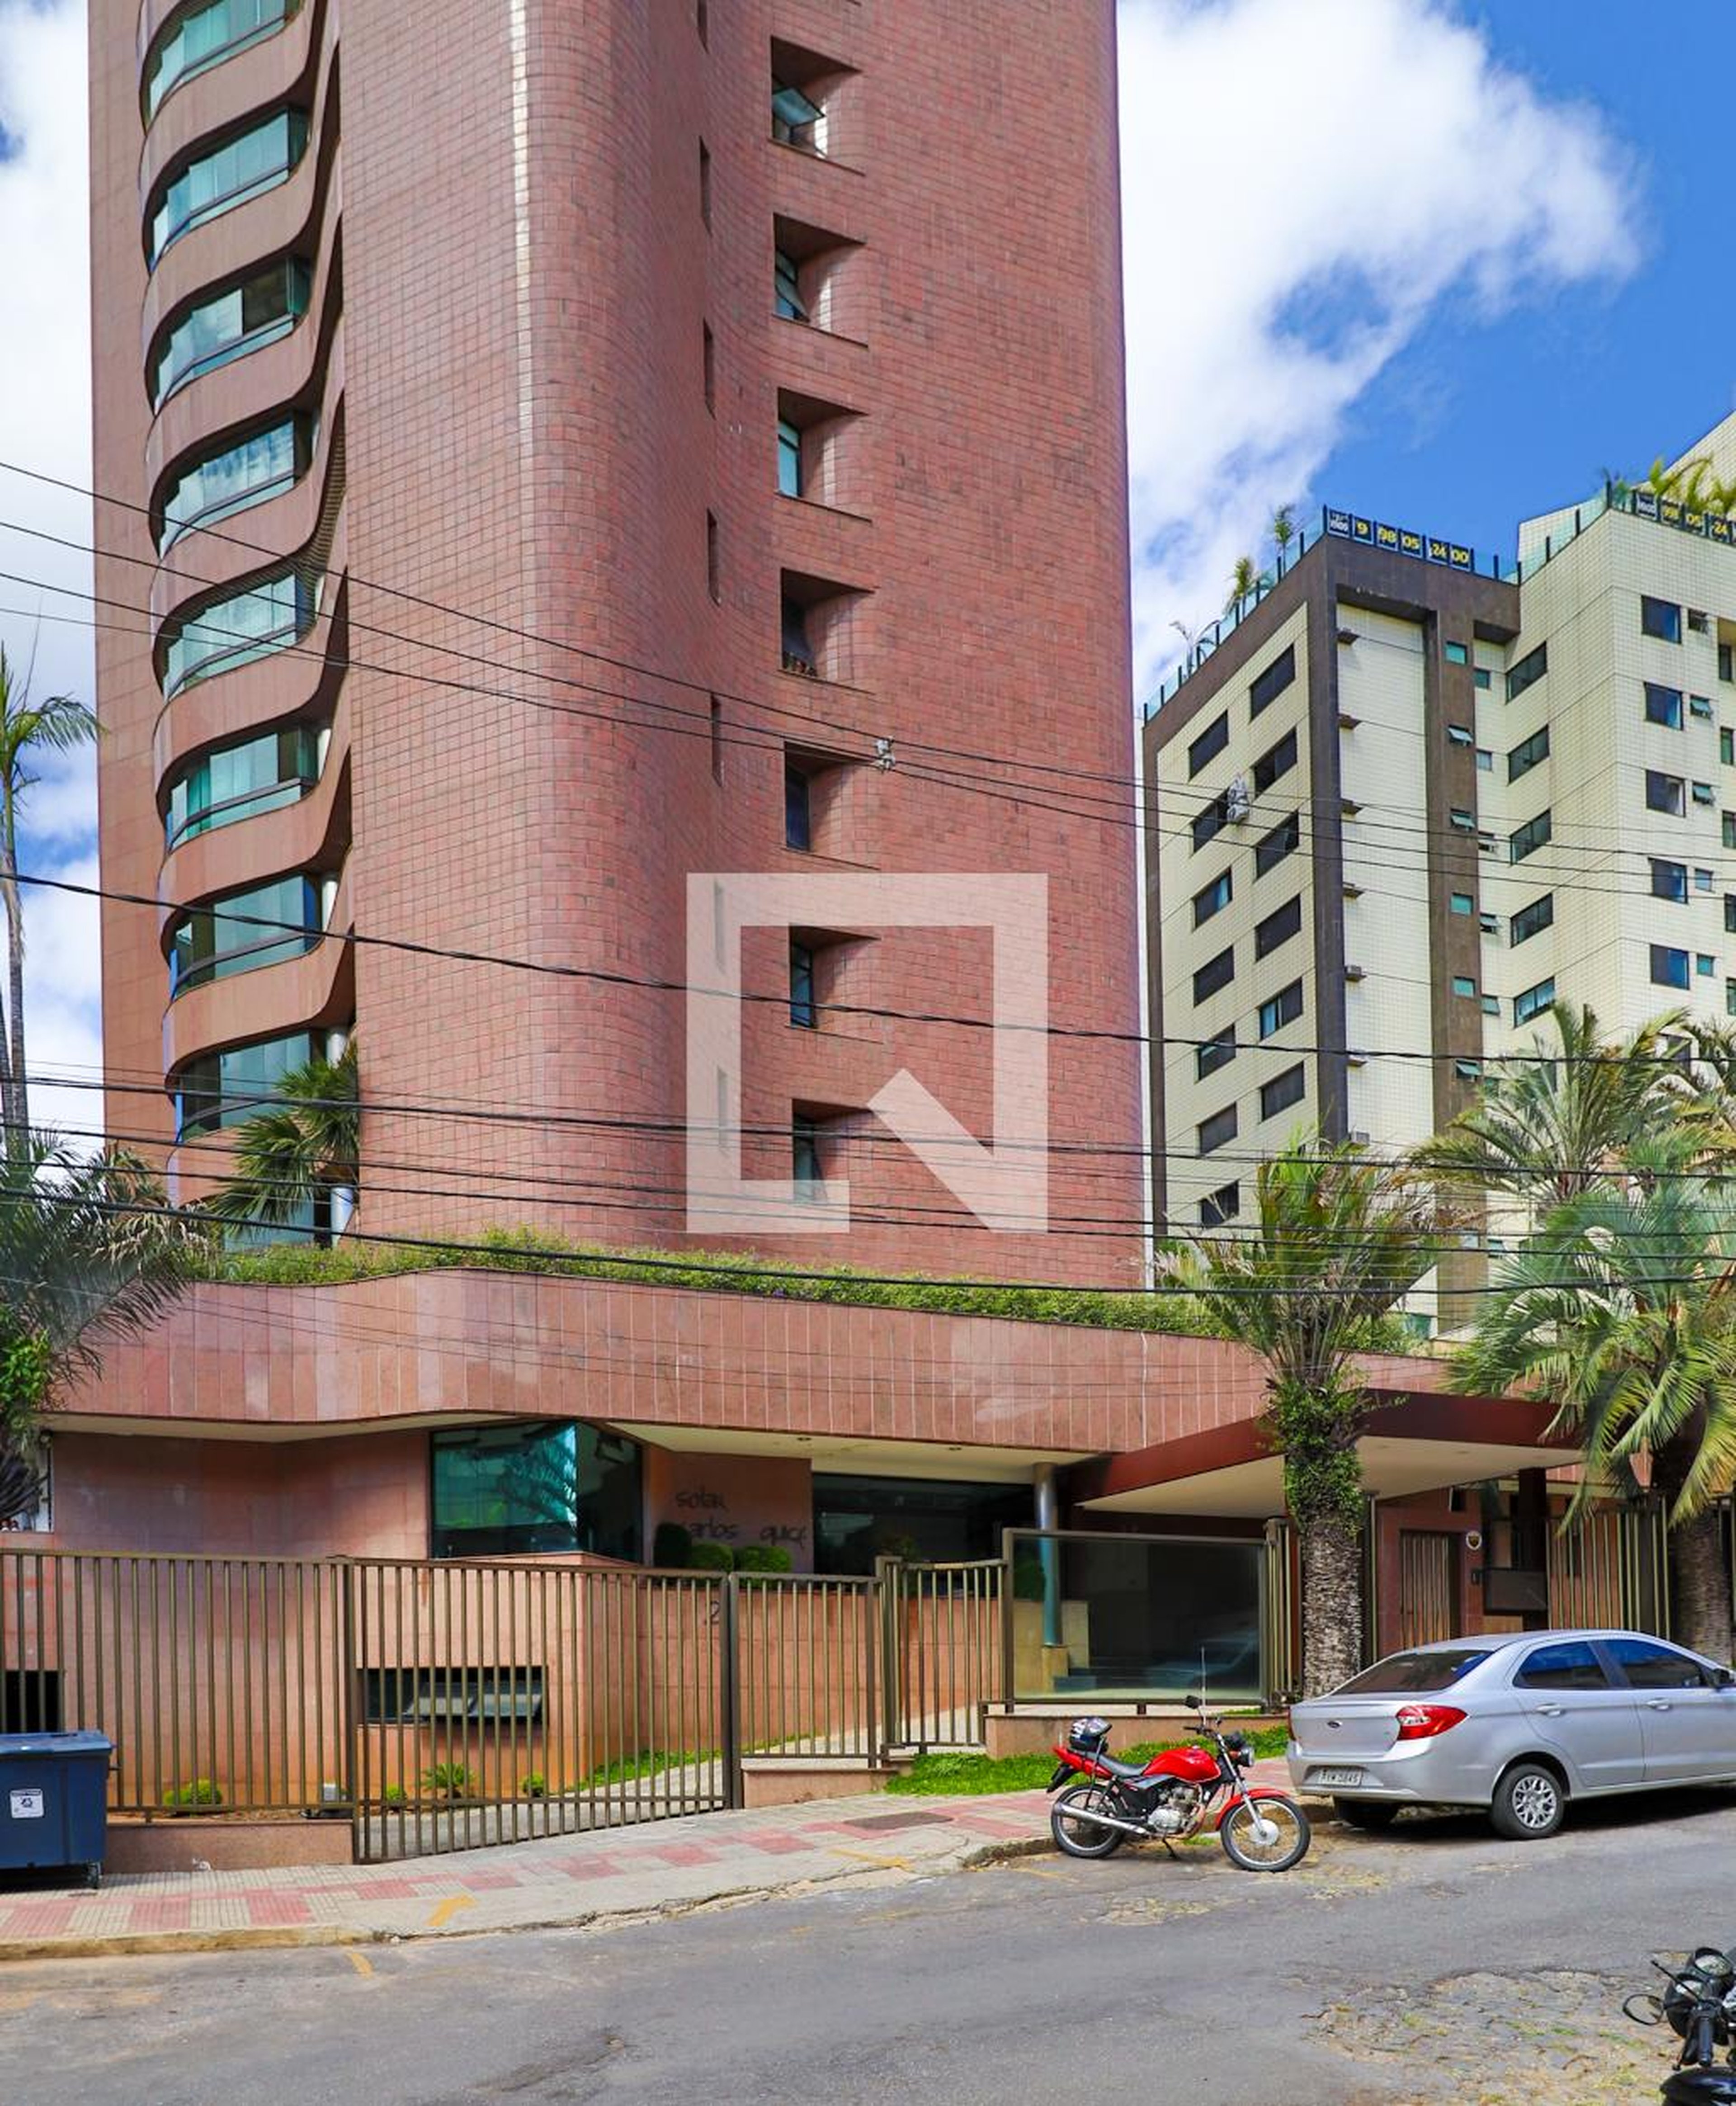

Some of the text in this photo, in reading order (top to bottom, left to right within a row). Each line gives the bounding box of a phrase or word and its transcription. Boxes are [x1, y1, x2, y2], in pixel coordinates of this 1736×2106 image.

[1357, 521, 1368, 535] 9
[1402, 535, 1420, 550] 05
[1450, 549, 1469, 563] 00
[682, 1516, 739, 1540] arlos
